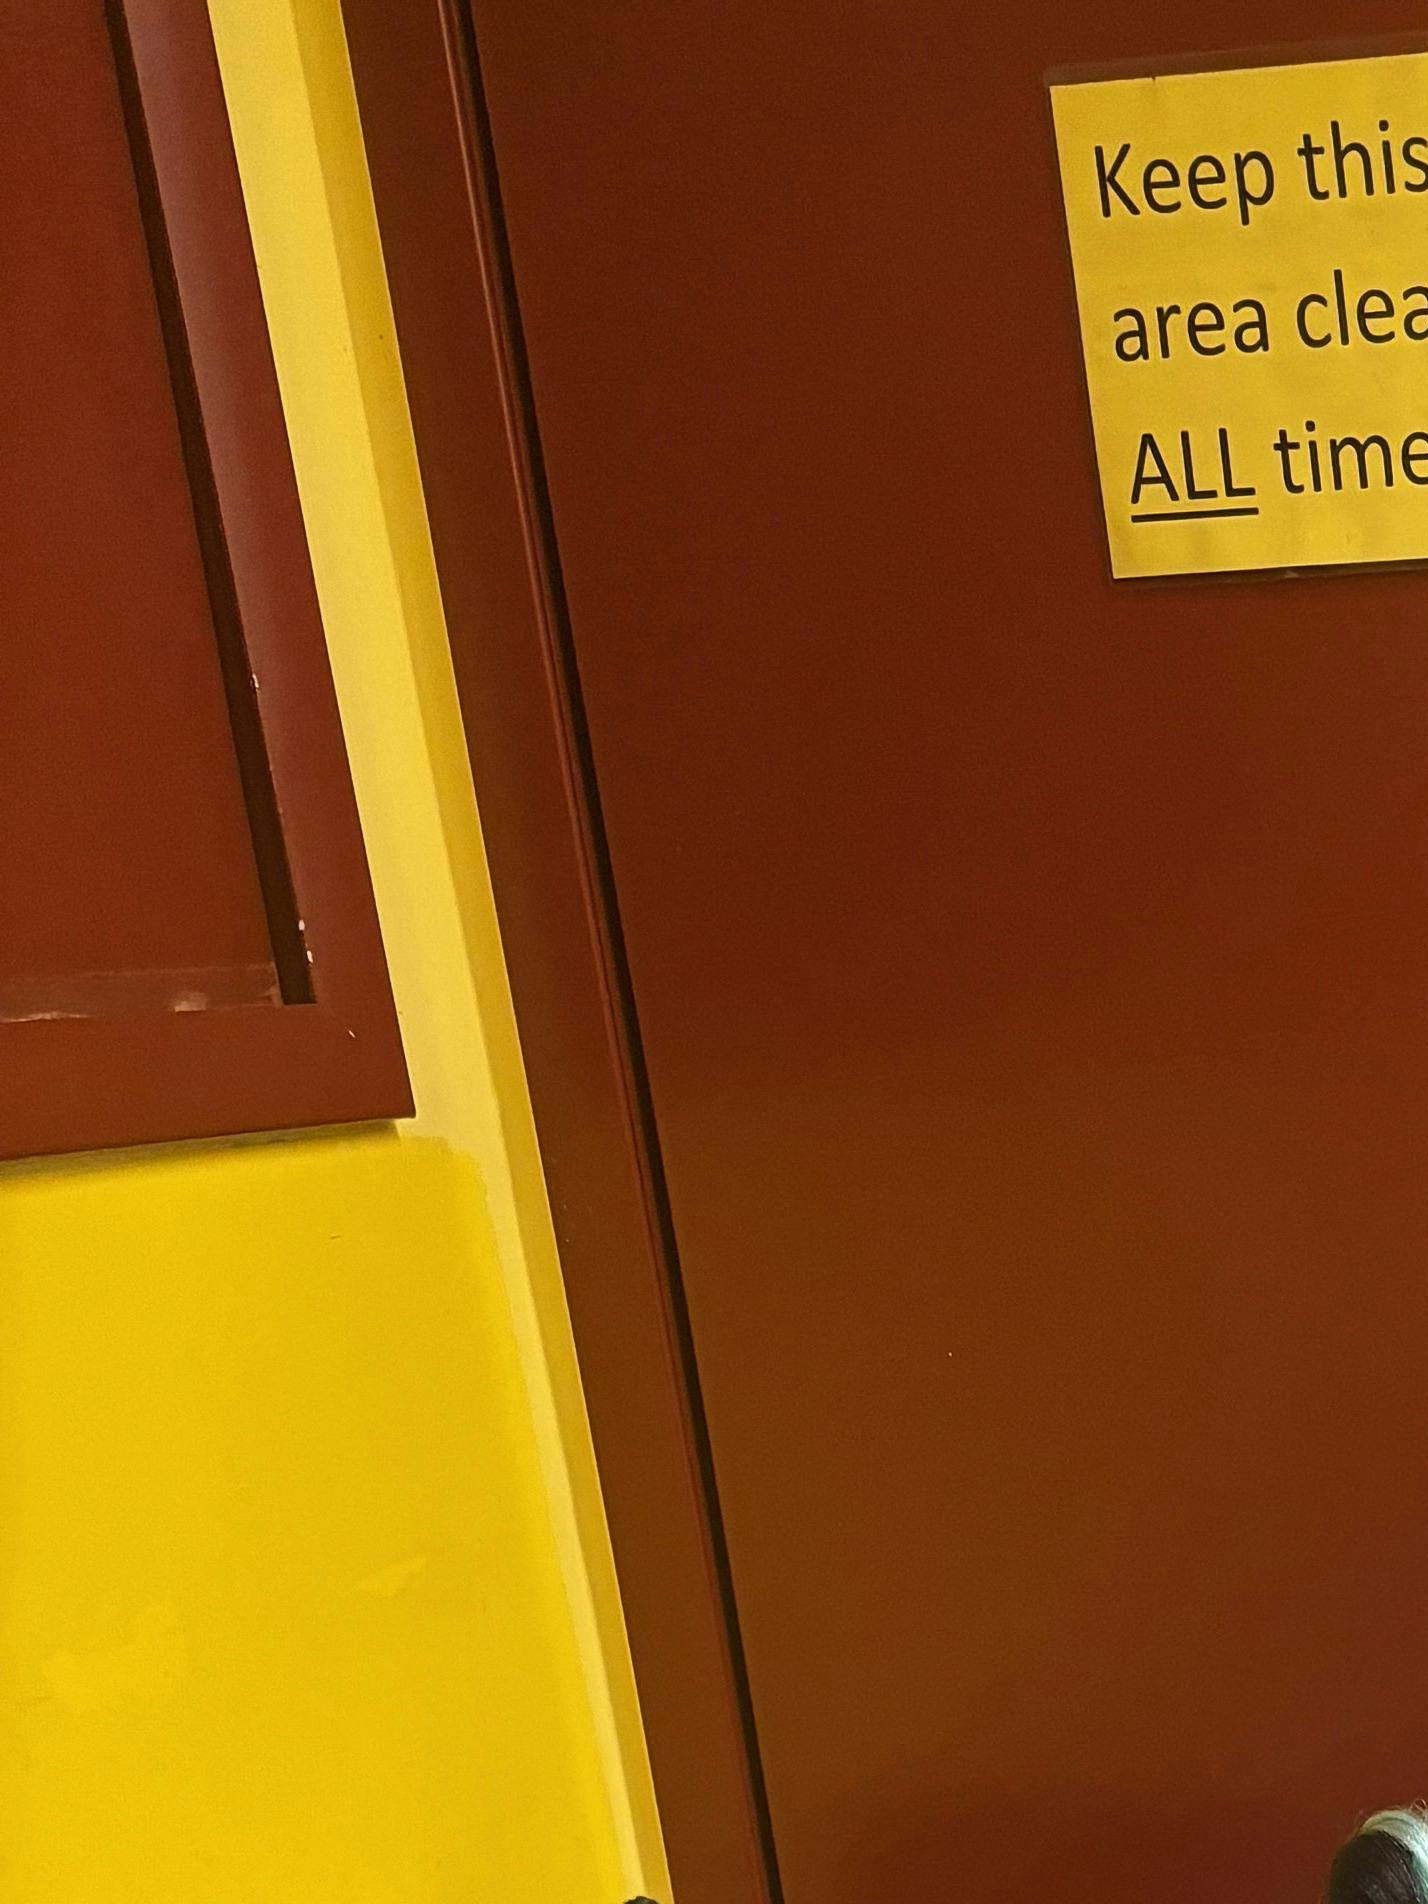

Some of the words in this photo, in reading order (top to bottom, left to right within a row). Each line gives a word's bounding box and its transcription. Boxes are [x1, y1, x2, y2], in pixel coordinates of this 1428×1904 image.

[1094, 142, 1276, 226] Keep
[1112, 295, 1271, 363] area
[1130, 426, 1259, 506] ALL
